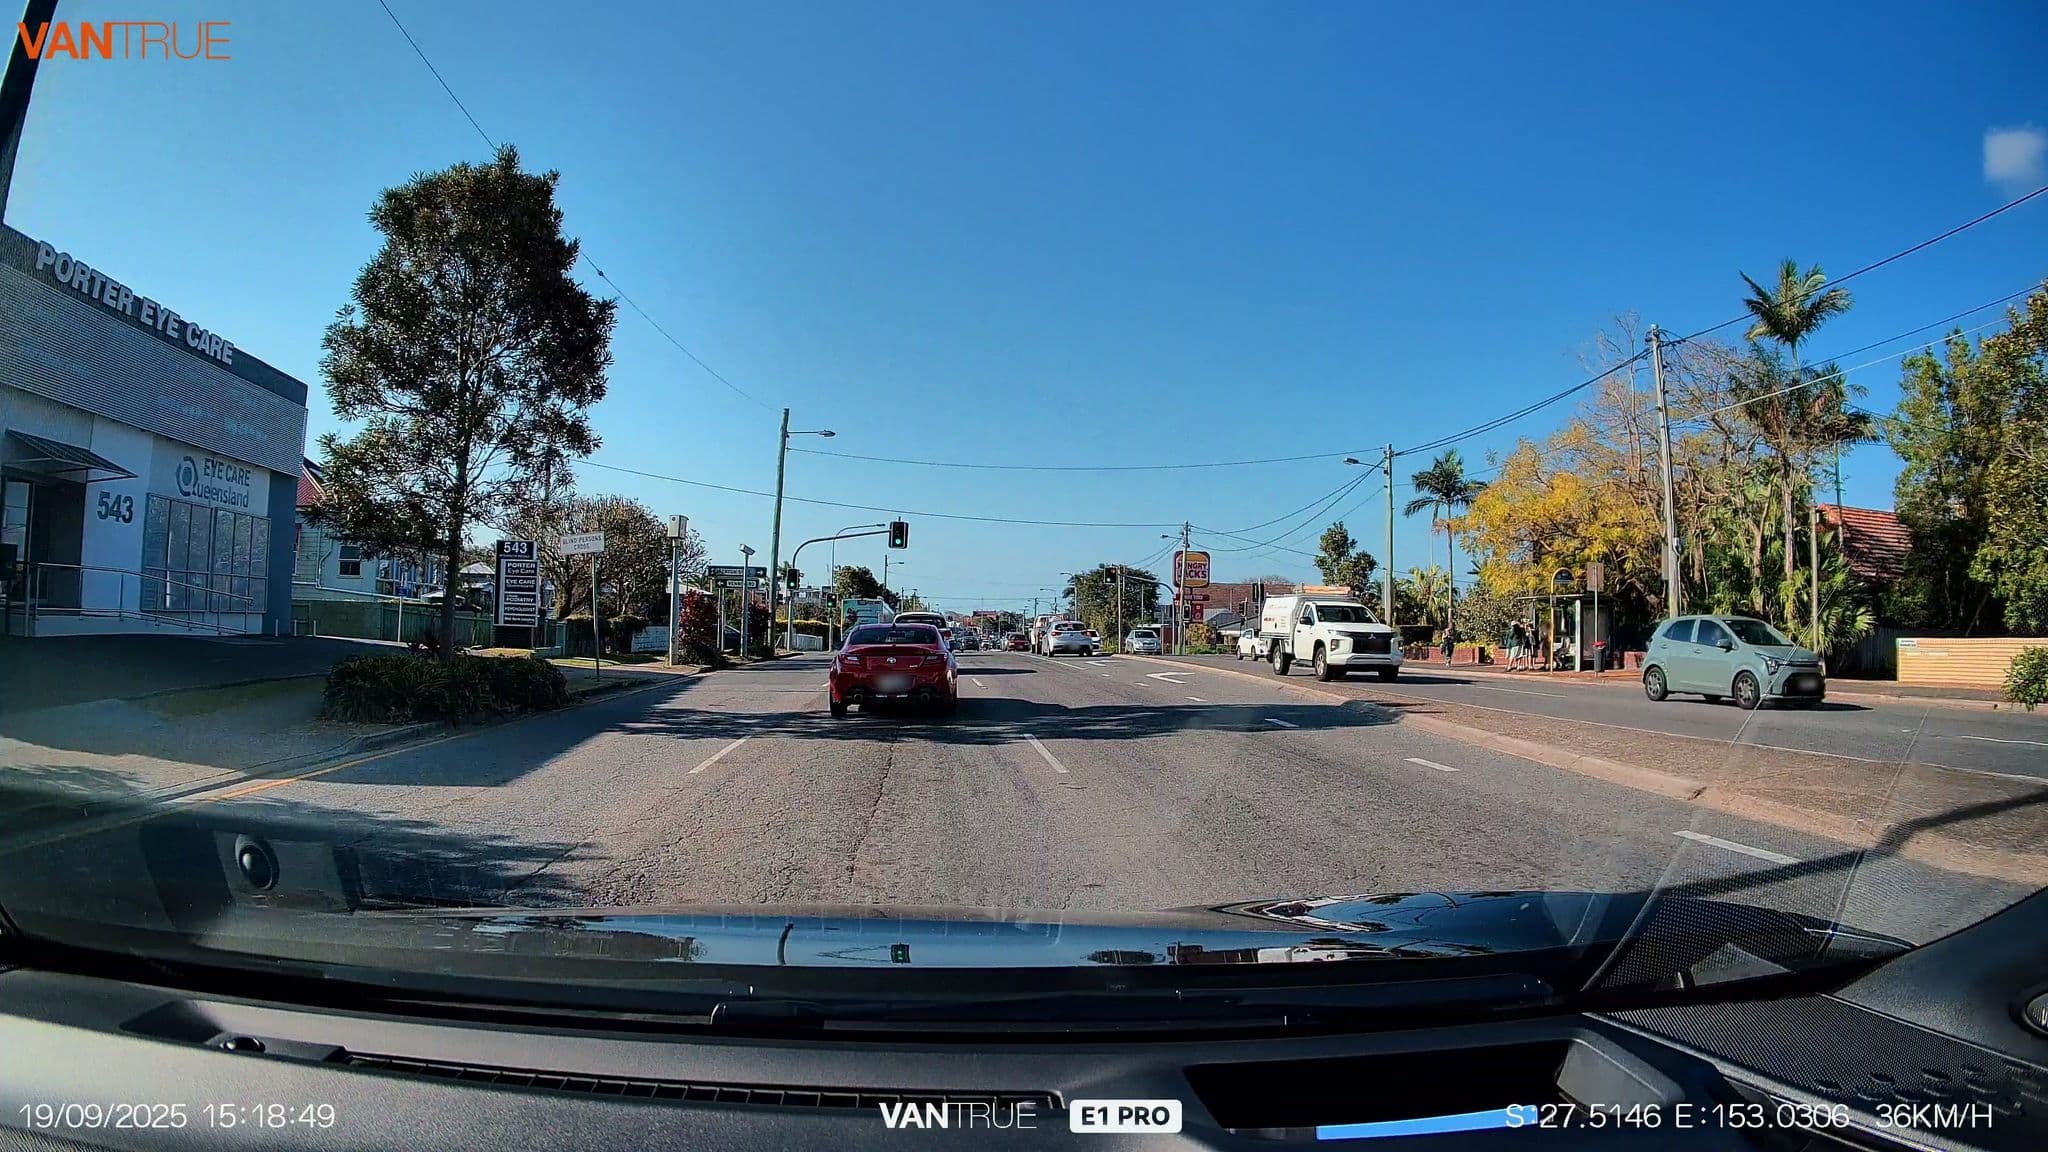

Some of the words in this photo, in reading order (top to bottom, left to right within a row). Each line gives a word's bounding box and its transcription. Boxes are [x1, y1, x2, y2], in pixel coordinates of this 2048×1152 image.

[36, 240, 133, 316] PORTER
[140, 296, 181, 339] EYE
[185, 322, 234, 365] CARE
[204, 457, 224, 480] EYE
[226, 464, 251, 487] CARE
[97, 491, 134, 524] 543
[503, 541, 528, 554] 543
[563, 537, 577, 545] BLIND
[579, 535, 602, 543] PERSONS
